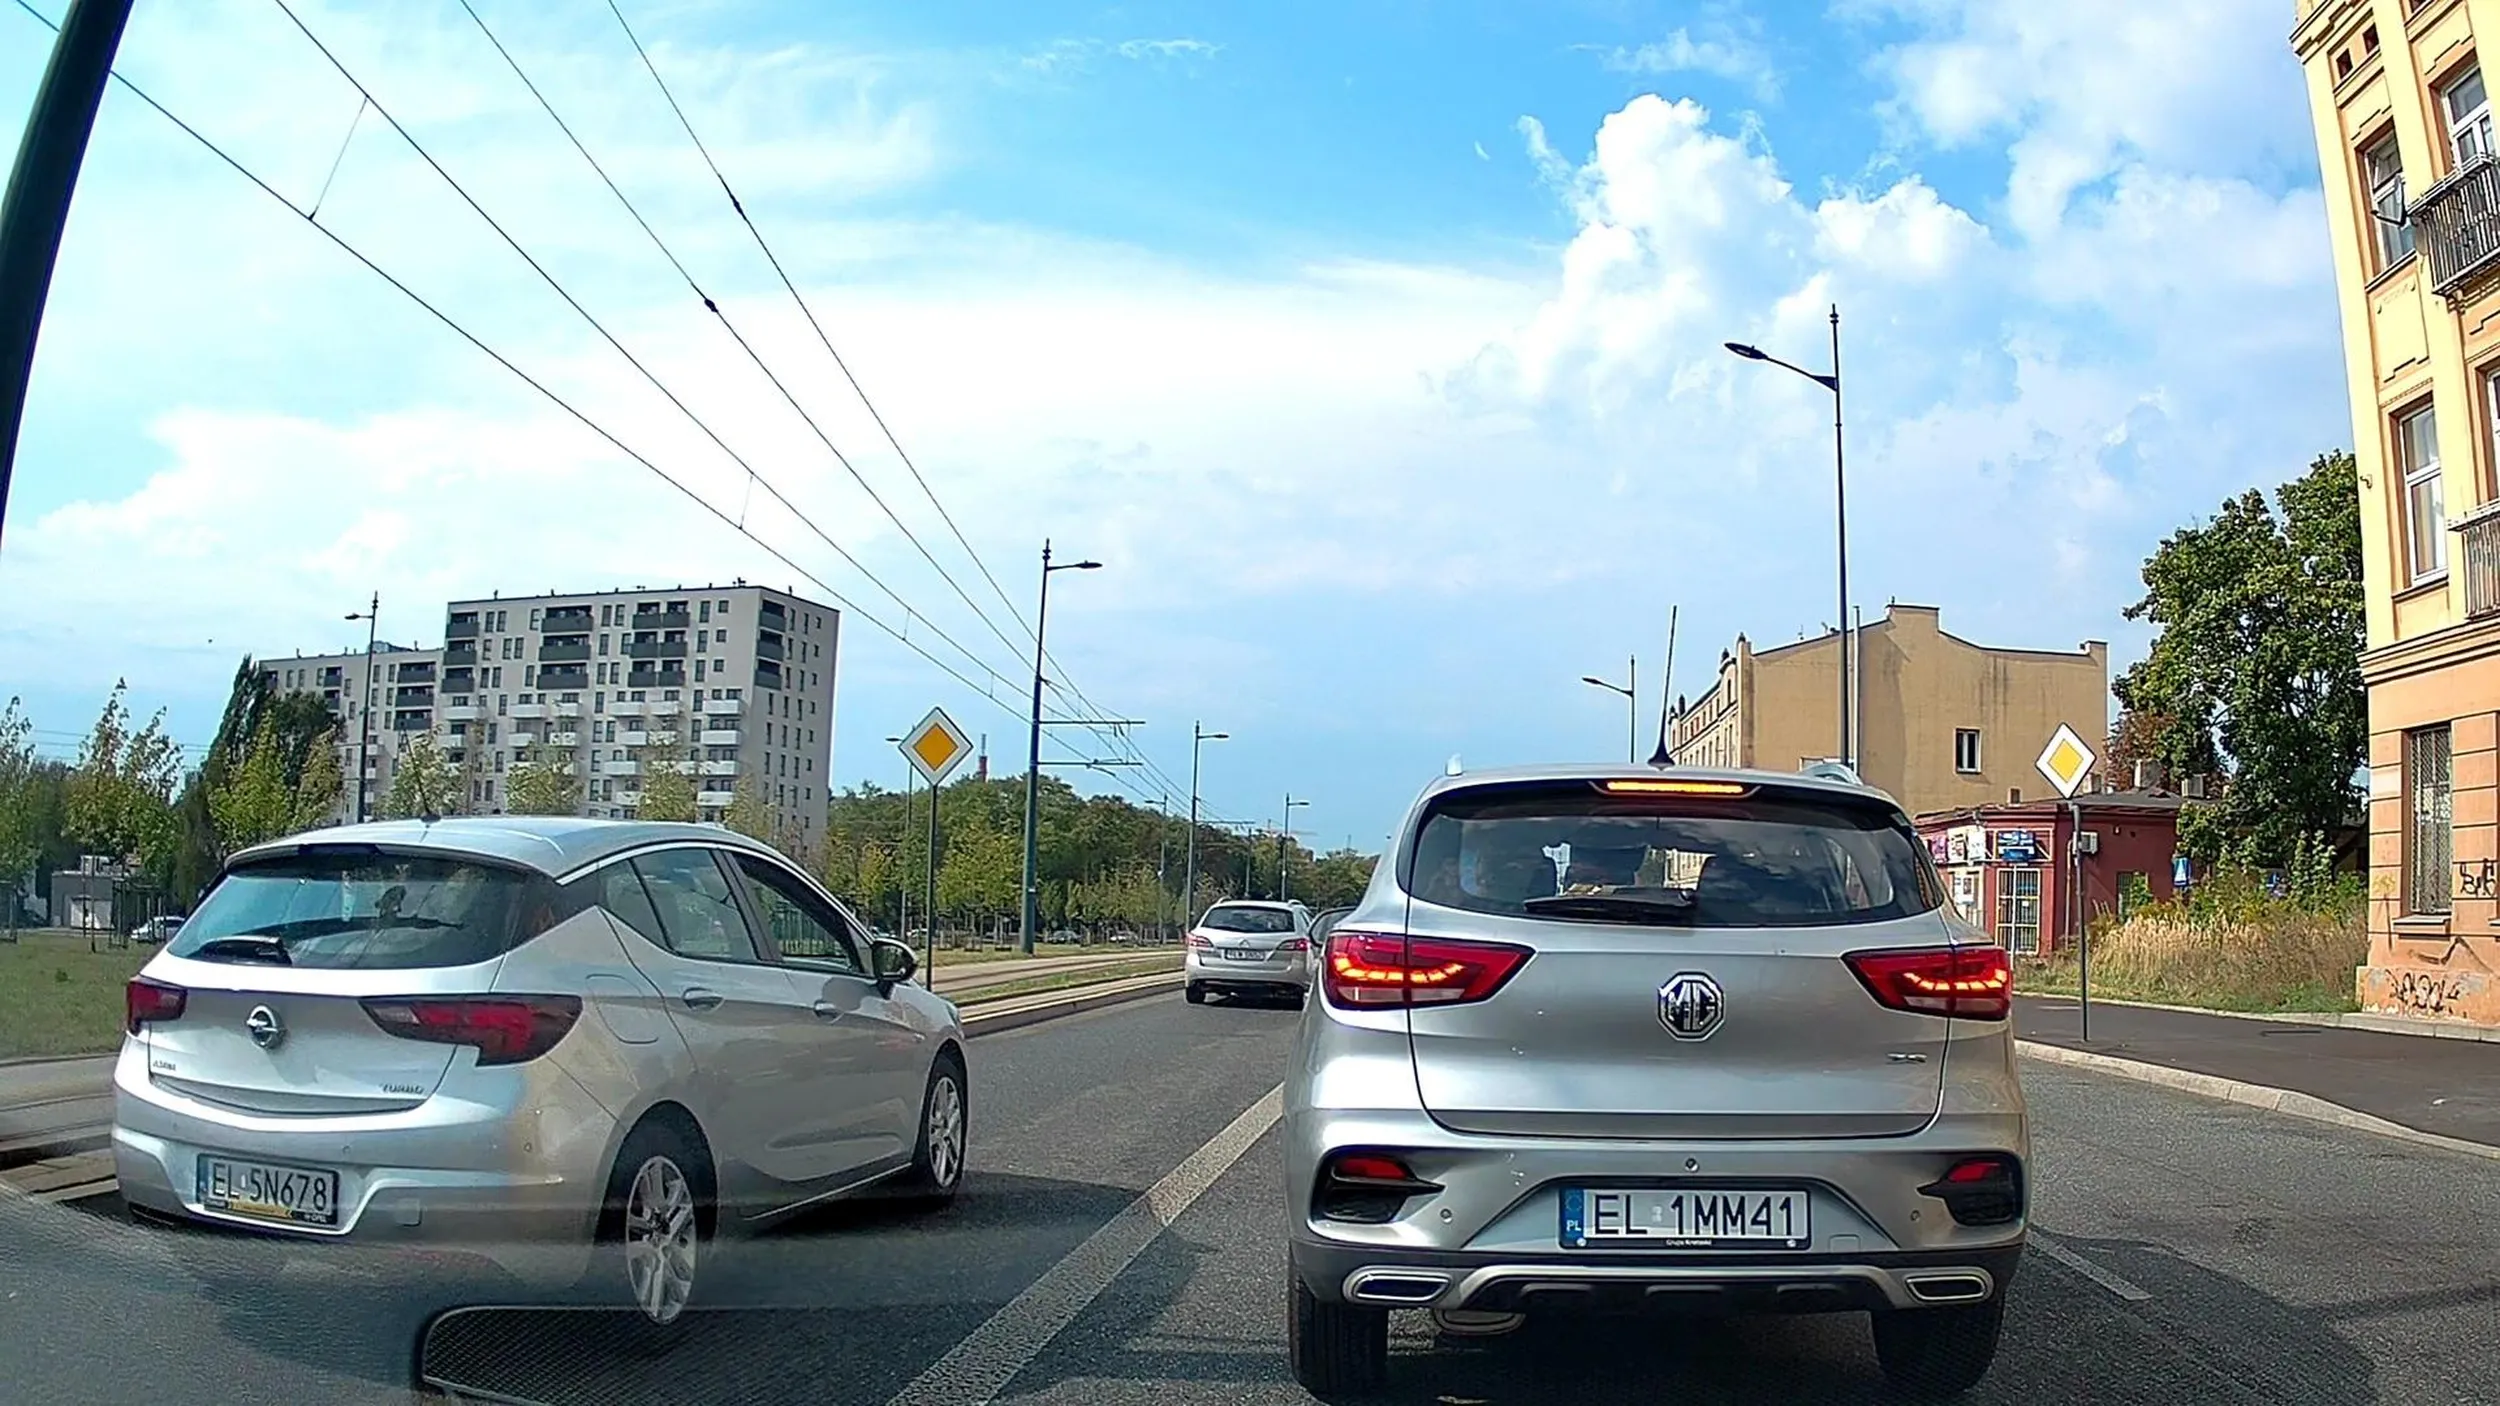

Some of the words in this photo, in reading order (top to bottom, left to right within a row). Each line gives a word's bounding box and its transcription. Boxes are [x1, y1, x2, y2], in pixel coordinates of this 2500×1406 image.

[1666, 981, 1717, 1031] MG
[213, 1162, 240, 1200] EL
[250, 1167, 327, 1212] 5N678
[1566, 1219, 1582, 1232] PL
[1594, 1194, 1648, 1235] EL
[1671, 1194, 1793, 1236] 1MM41
